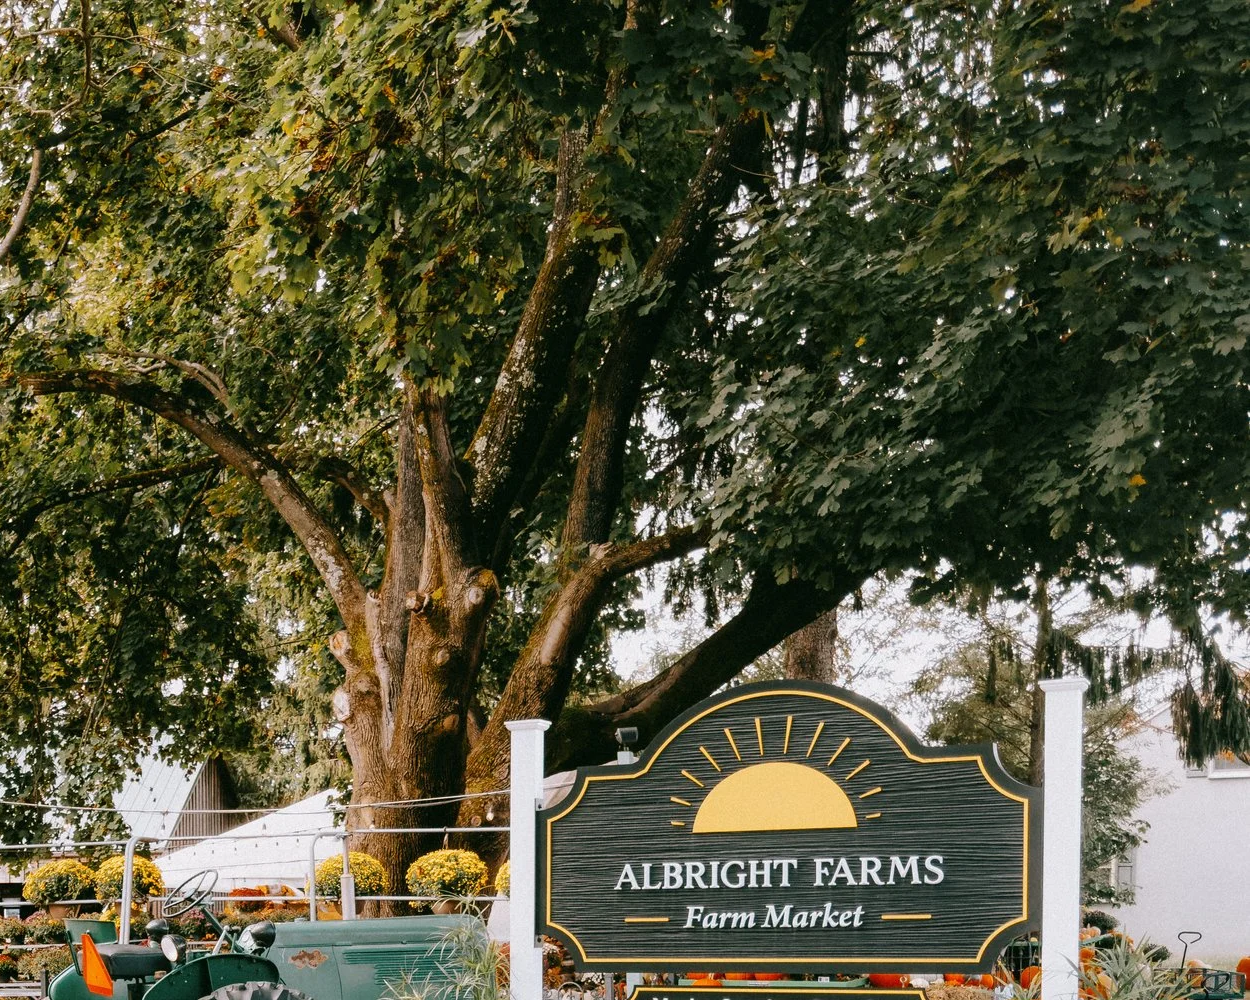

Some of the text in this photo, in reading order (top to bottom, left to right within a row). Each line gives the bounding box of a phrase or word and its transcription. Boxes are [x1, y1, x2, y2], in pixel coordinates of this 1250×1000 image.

[613, 855, 946, 891] ALBRIGHT FARMS
[682, 902, 865, 930] Farm Market
